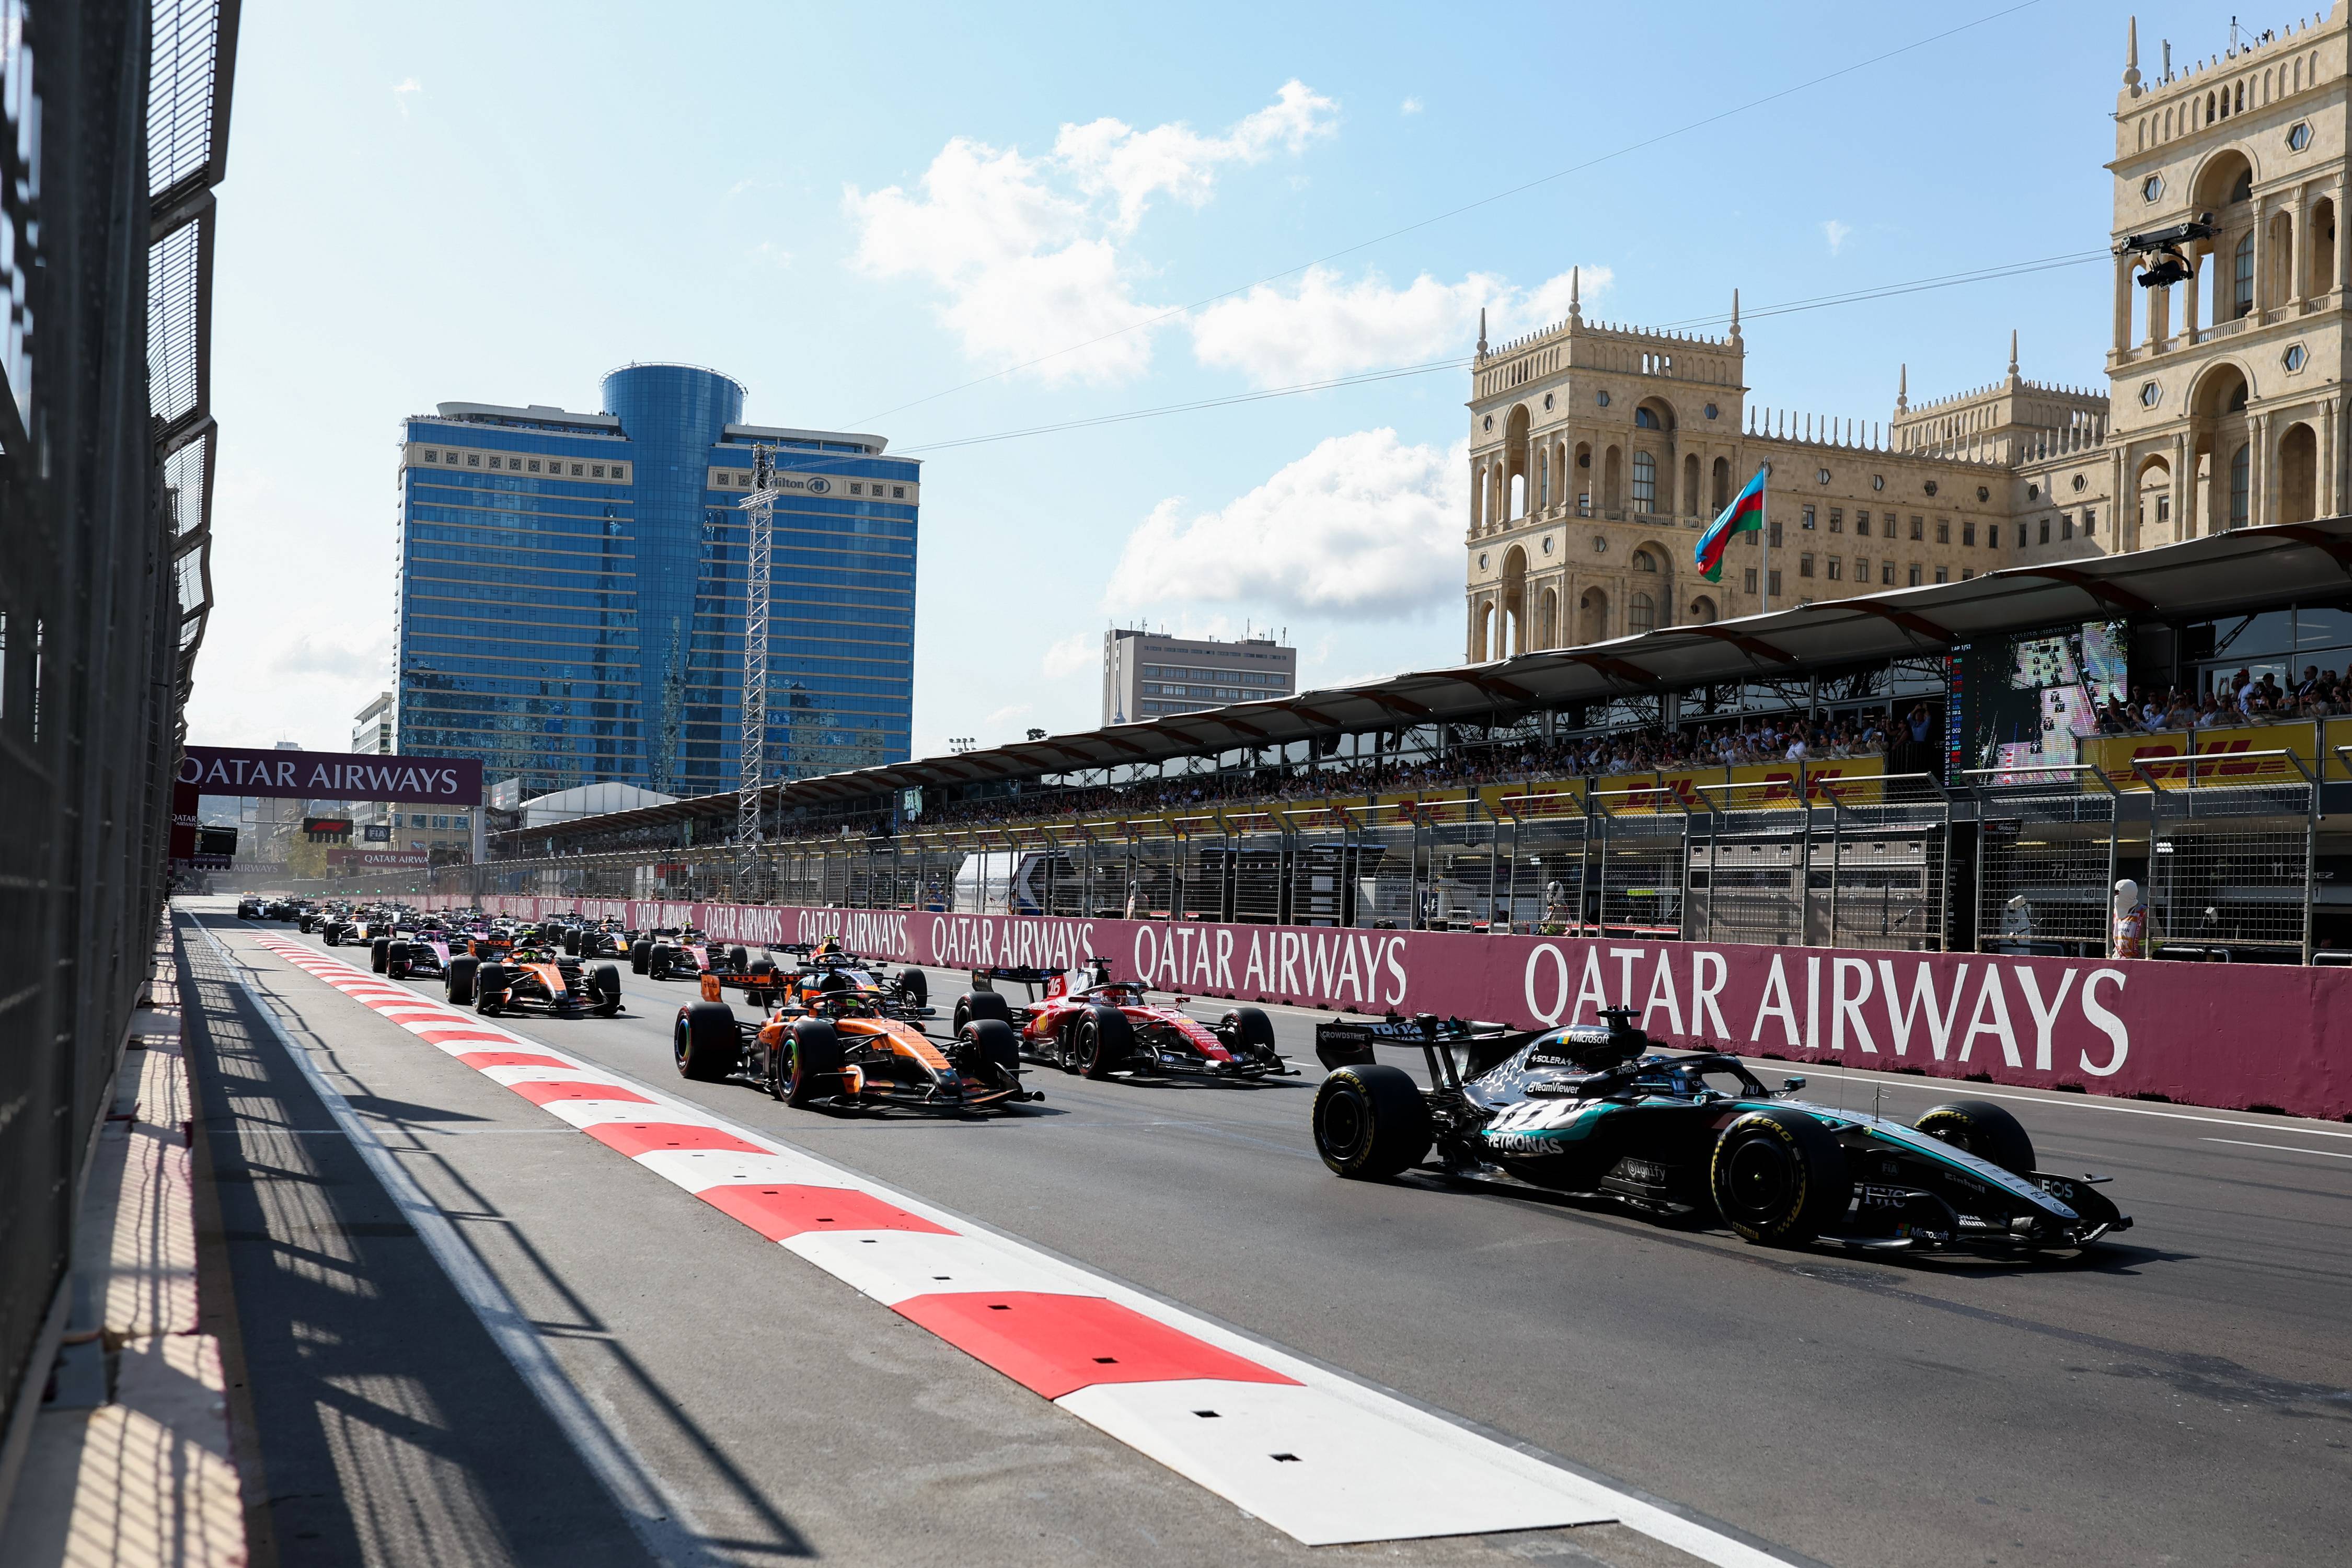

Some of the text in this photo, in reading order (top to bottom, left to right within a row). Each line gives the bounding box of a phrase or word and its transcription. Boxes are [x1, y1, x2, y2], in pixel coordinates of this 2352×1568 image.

[2129, 740, 2261, 781] DHL
[176, 757, 458, 794] QATAR AIRWAYS
[1763, 769, 1847, 799] DHL
[1625, 779, 1696, 809] DHL
[171, 813, 197, 822] QATAR
[233, 864, 279, 872] AIRWAYS
[364, 854, 429, 864] QATAR AIRWA
[2051, 863, 2065, 877] 77
[2084, 890, 2094, 898] 40
[636, 903, 659, 931] QATAR
[704, 906, 782, 944] QATAR AIRWAYS
[798, 910, 907, 958] QATAR AIRWAYS
[931, 915, 1094, 971] QATAR AIRWAYS
[1134, 925, 1407, 1007] QATAR AIRWAYS
[1047, 978, 1061, 996] 16
[1524, 942, 2129, 1077] QATAR AIRWAYS
[1322, 1030, 1365, 1041] CROWDSTRIKE
[1571, 1033, 1610, 1045] Microsoft
[1536, 1055, 1566, 1065] SOLERA
[1617, 1066, 1632, 1075] AMD
[1664, 1060, 1703, 1069] CROWDSTRIKE
[1340, 1071, 1366, 1093] ZERO
[1534, 1082, 1579, 1094] TeamViewer
[1737, 1117, 1793, 1142] P ZERO
[1488, 1132, 1564, 1154] PETRONAS
[1628, 1159, 1666, 1181] signify
[1944, 1172, 1986, 1194] Einhell
[1864, 1186, 1906, 1208] IWC
[1910, 1227, 1950, 1241] Microsoft
